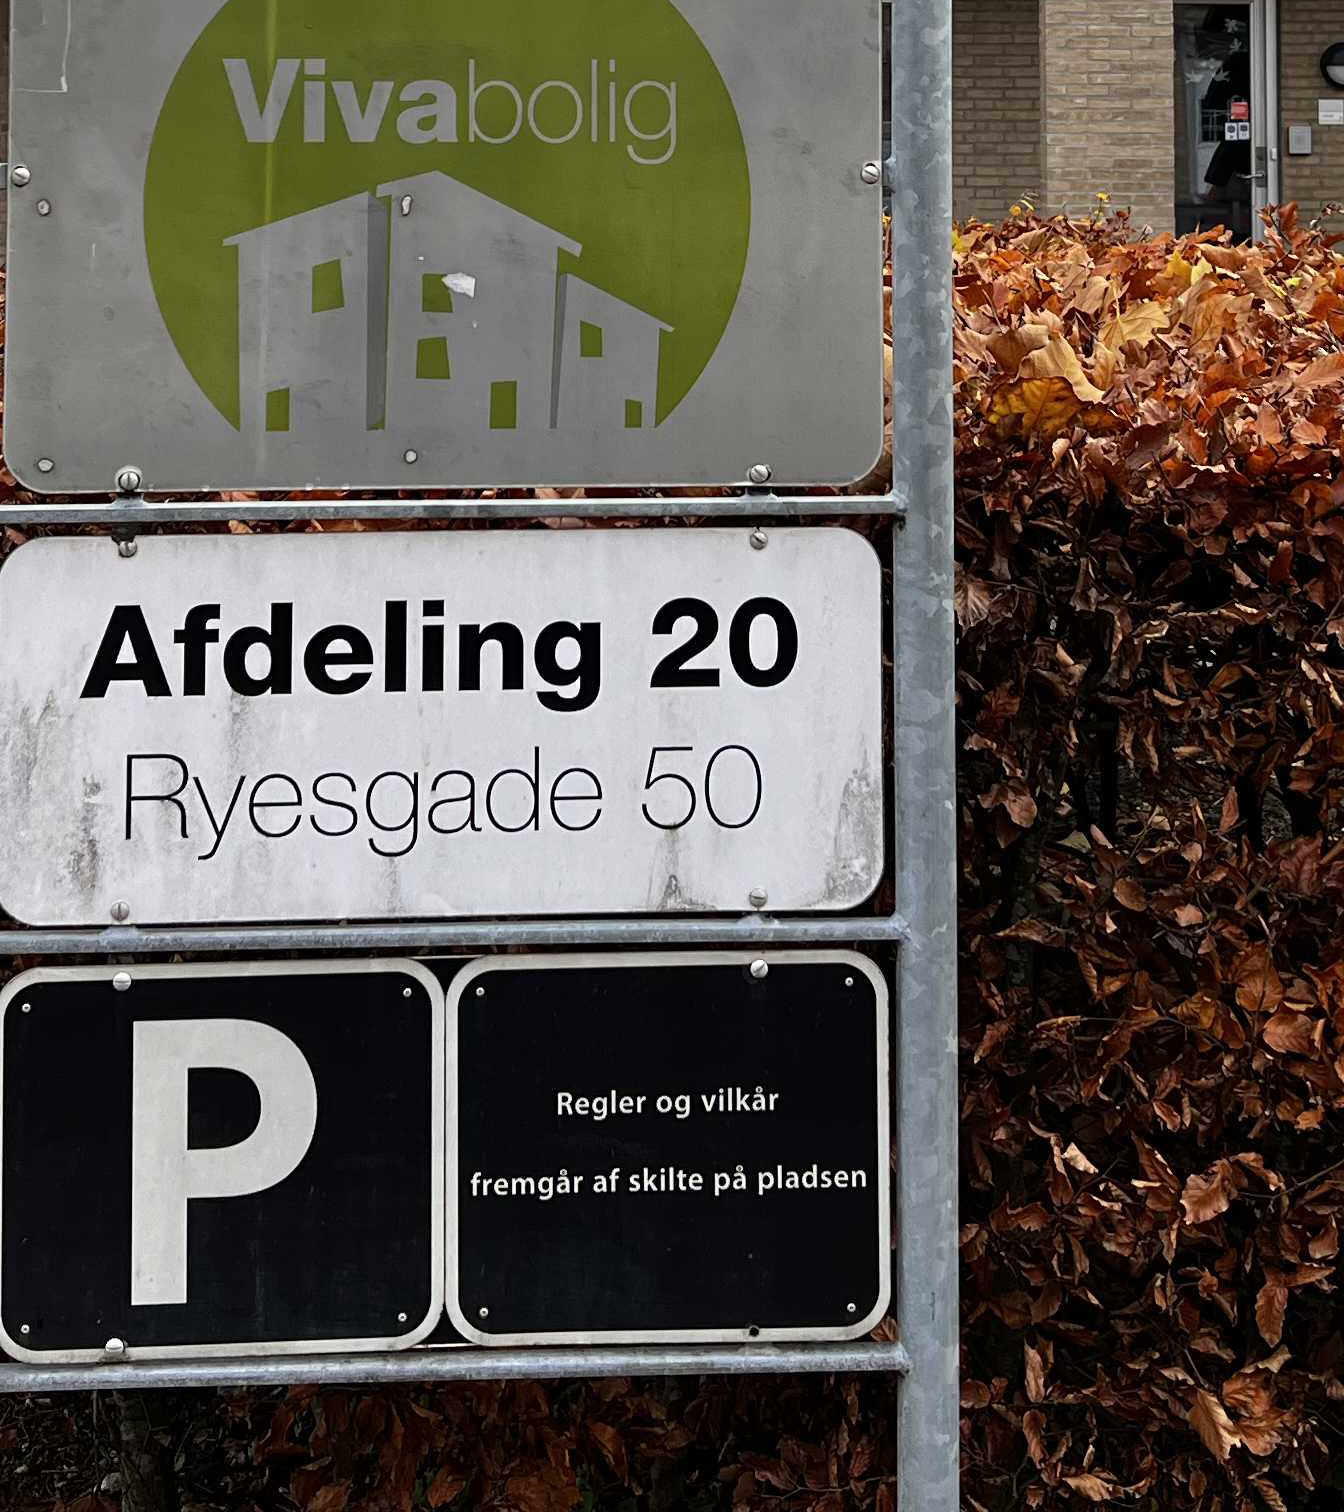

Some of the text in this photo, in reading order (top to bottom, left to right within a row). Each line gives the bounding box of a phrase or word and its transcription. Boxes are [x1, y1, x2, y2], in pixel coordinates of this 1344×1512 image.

[222, 57, 679, 165] Vivabolig
[79, 596, 800, 713] Afdeling 20
[124, 744, 763, 861] Ryesgade 50
[556, 1086, 779, 1121] Regler og vilkår
[130, 1018, 318, 1306] P
[470, 1163, 867, 1201] fremgår af skilte på pladsen
